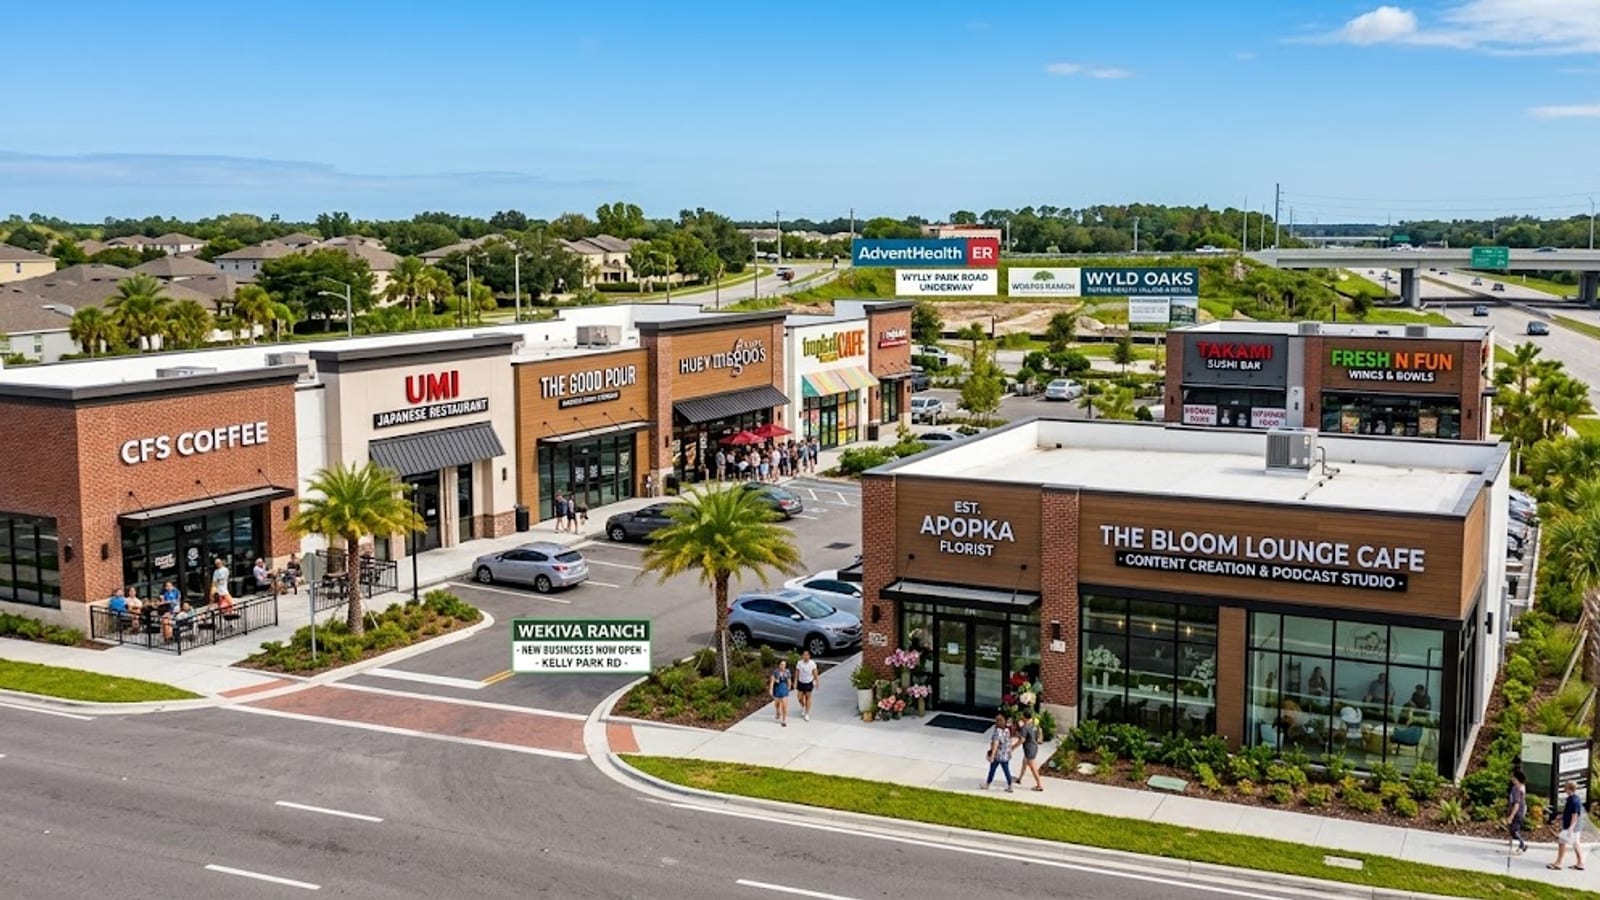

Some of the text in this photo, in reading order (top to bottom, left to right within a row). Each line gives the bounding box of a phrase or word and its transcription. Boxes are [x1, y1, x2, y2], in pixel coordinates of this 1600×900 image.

[858, 246, 993, 259] AdventHealth ER
[935, 273, 960, 281] PARK
[961, 273, 989, 281] ROAD
[1086, 272, 1194, 286] WYLD OAKS
[919, 283, 974, 291] UNDERWAY
[837, 329, 865, 358] CAFE
[1198, 342, 1273, 360] TAKAMI
[680, 354, 711, 374] HUEY
[1207, 359, 1238, 369] SUSHI
[1331, 350, 1453, 371] FRESH N FUN
[541, 375, 566, 399] THE
[569, 370, 602, 394] GOOD
[604, 365, 636, 389] POUR
[1386, 371, 1394, 380] &
[1396, 371, 1434, 382] BOWLS
[405, 370, 459, 404] UMI
[377, 399, 488, 426] JAPANESE RESTAURANT
[120, 421, 269, 465] CFS COFFEE
[954, 501, 981, 514] EST.
[920, 515, 1015, 542] APOPKA
[940, 540, 994, 556] FLORIST
[1100, 525, 1425, 572] THE BLOOM LOUNGE CAFE
[1125, 554, 1396, 588] CONTENT CREATION & PODCAST STUDIO
[518, 624, 646, 638] WEKIVA RANCH
[521, 645, 541, 655] NEW
[595, 645, 617, 655] NOW
[619, 645, 642, 655] OPEN
[541, 658, 622, 668] KELLY PARK RD
